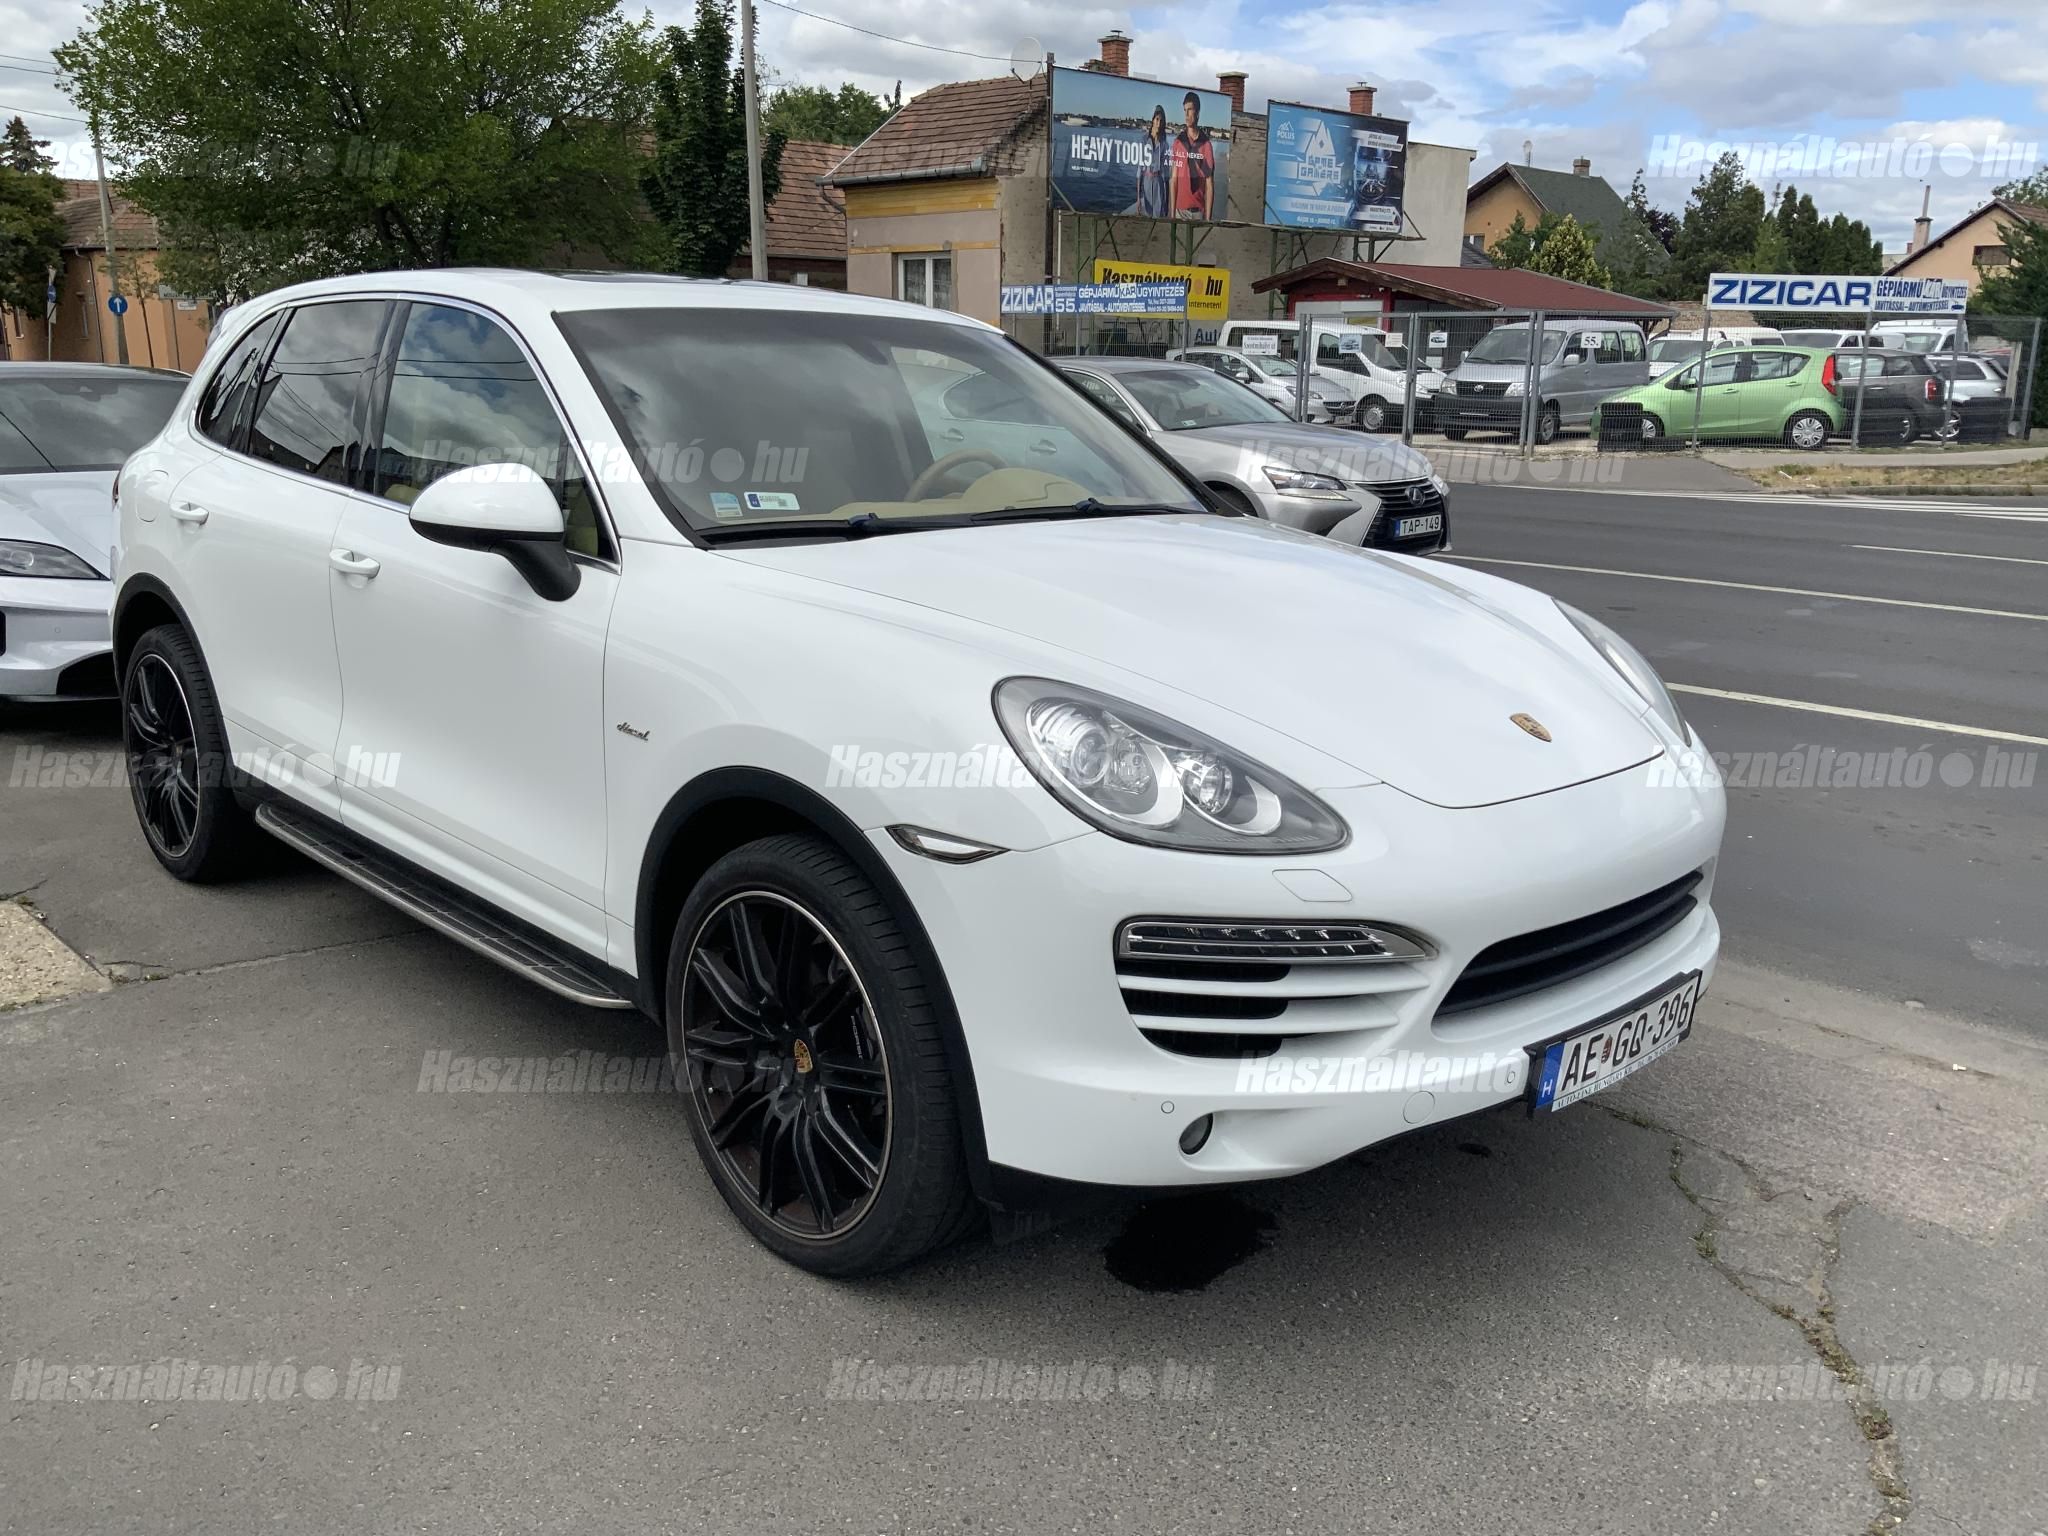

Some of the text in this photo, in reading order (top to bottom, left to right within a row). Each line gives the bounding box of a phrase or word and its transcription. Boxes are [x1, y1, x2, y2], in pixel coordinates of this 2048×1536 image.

[1071, 134, 1113, 163] HEAVY
[1113, 141, 1153, 167] TOOLS
[1136, 283, 1185, 298] ÜGYINTÉZÉS
[1205, 276, 1224, 297] hu
[1711, 279, 1871, 307] ZIZICAR
[1876, 277, 1924, 299] GÉPJÁRMŰ
[1001, 286, 1054, 312] ZIZICAR
[1055, 298, 1077, 313] 55.
[1194, 327, 1220, 342] Aut
[1584, 336, 1599, 346] 55.
[1402, 516, 1440, 534] TAP-149
[1561, 1032, 1604, 1092] AE
[1541, 1080, 1553, 1098] H
